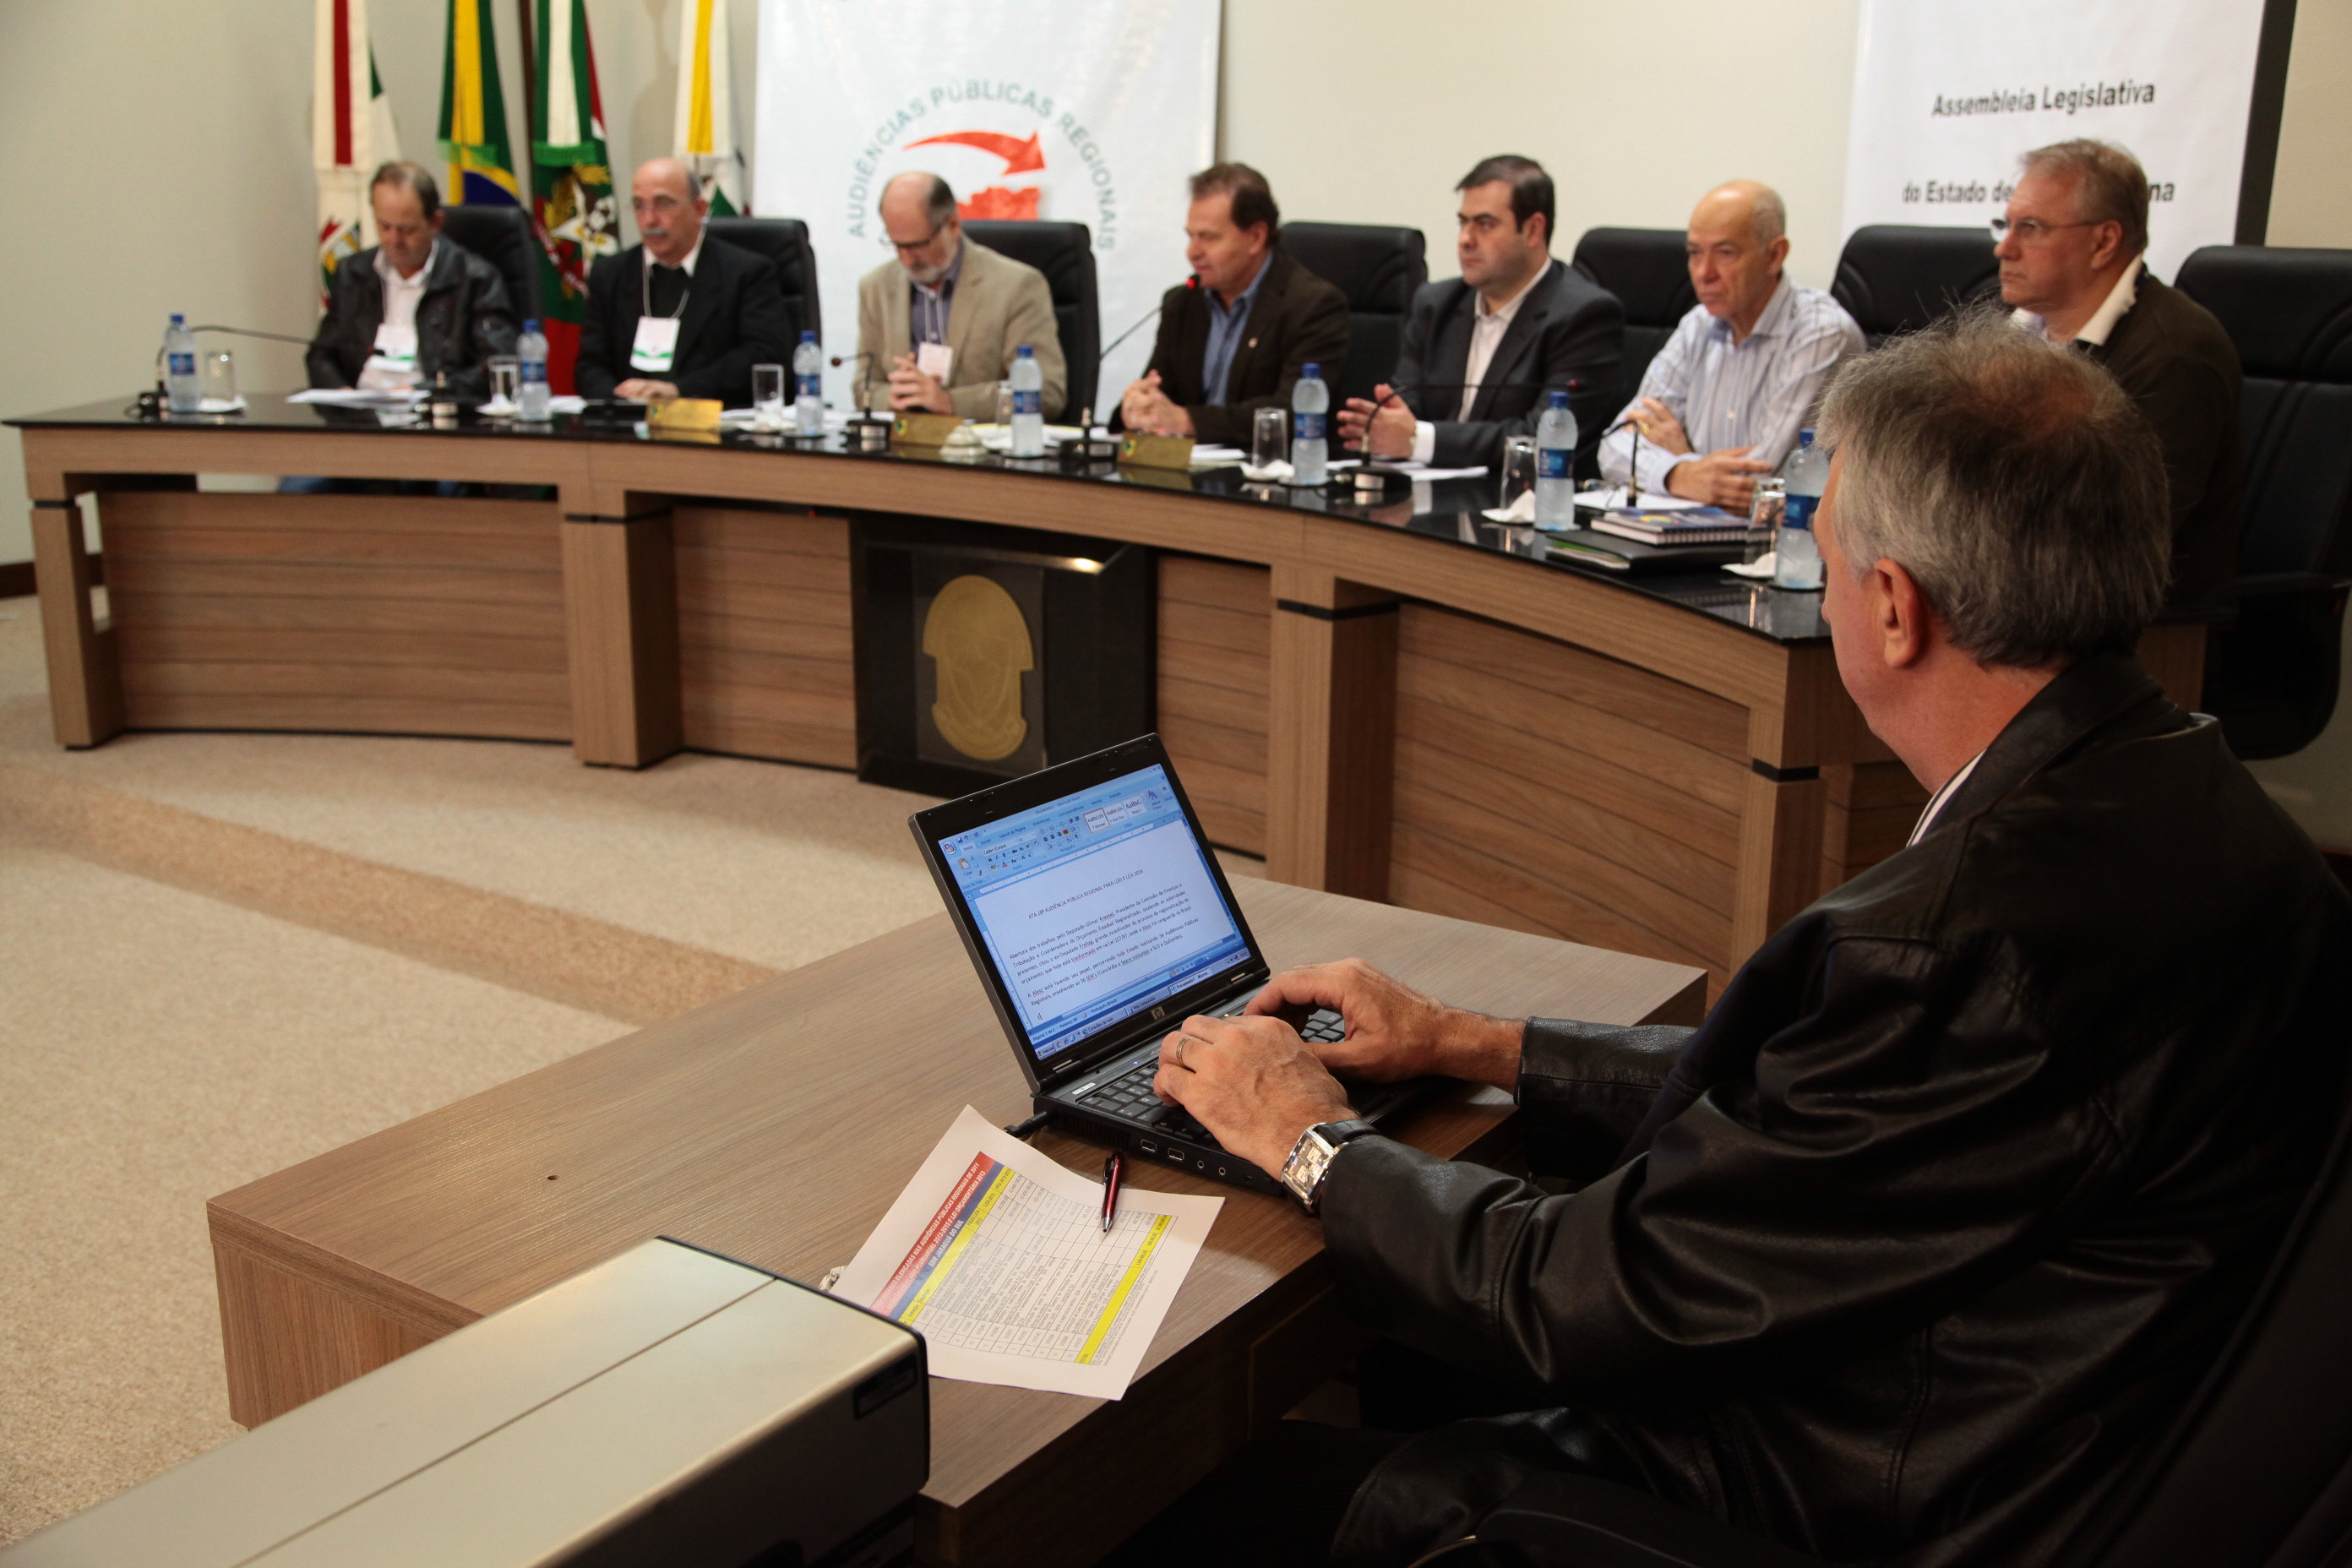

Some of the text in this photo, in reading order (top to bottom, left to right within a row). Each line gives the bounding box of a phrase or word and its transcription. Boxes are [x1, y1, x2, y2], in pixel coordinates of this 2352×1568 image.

[1931, 79, 2156, 118] Assembleia Legislativa
[930, 78, 1054, 119] PÚBLICAS
[1056, 110, 1116, 251] REGIONAIS
[1903, 181, 2014, 204] do Estado de
[1043, 899, 1067, 912] AUDIÊNCIA
[1065, 891, 1084, 903] PÚBLICA
[1083, 885, 1102, 896] REGIONAL
[1102, 880, 1114, 889] PARA
[1009, 948, 1027, 959] Abertura
[1036, 936, 1055, 948] trabalhos
[1055, 932, 1066, 940] pelo
[1065, 923, 1086, 936] Deputado
[1084, 917, 1098, 927] Gilmar
[1114, 901, 1135, 914] Presidente
[1141, 892, 1158, 903] Comissão
[1162, 884, 1179, 895] Finanças
[1013, 955, 1036, 968] Tributação
[1040, 940, 1068, 956] Coordenadora
[1075, 928, 1098, 942] Orçamento
[1097, 920, 1113, 930] Estadual
[1141, 901, 1159, 912] saudando
[1164, 890, 1185, 901] autoridades
[1016, 963, 1038, 977] presentes,
[1053, 945, 1079, 961] ex-Deputado
[1079, 939, 1094, 950] Freitag,
[1094, 932, 1108, 943] grande
[1108, 923, 1130, 935] incentivador
[1137, 913, 1153, 923] processo
[1158, 899, 1184, 914] regionalização
[1020, 970, 1044, 985] orçamento,
[1052, 962, 1062, 971] hoje
[1157, 912, 1176, 924] vanguarda
[1180, 905, 1192, 913] Brasil.
[1032, 987, 1043, 995] Alesc
[1054, 975, 1070, 985] fazendo
[1078, 966, 1092, 976] papel,
[1092, 955, 1116, 969] percorrendo
[1125, 944, 1139, 953] Estado
[1139, 935, 1158, 946] realizando
[1164, 923, 1184, 935] Audiências
[1184, 917, 1198, 927] Públicas
[1030, 993, 1053, 1007] Regionais,
[1051, 982, 1075, 996] envolvendo
[1096, 962, 1118, 977] (Concórdia
[1131, 948, 1150, 961] conjuntas
[969, 1162, 981, 1173] 2011
[974, 1170, 987, 1181] 2013
[950, 1178, 970, 1200] REGIONAIS
[952, 1179, 981, 1212] ORÇAMENTÁRIA
[934, 1200, 955, 1221] PÚBLICAS
[948, 1211, 958, 1219] LEI
[917, 1219, 941, 1245] AUDIÊNCIAS
[931, 1222, 950, 1243] 2012-2015
[952, 1219, 964, 1229] SUL
[912, 1245, 923, 1255] NAS
[913, 1243, 937, 1270] PLURIANUAL
[932, 1235, 953, 1257] JARAGUÁ
[893, 1254, 917, 1280] ELENCADAS
[927, 1257, 939, 1266] SDR
[902, 1269, 918, 1284] PLANO
